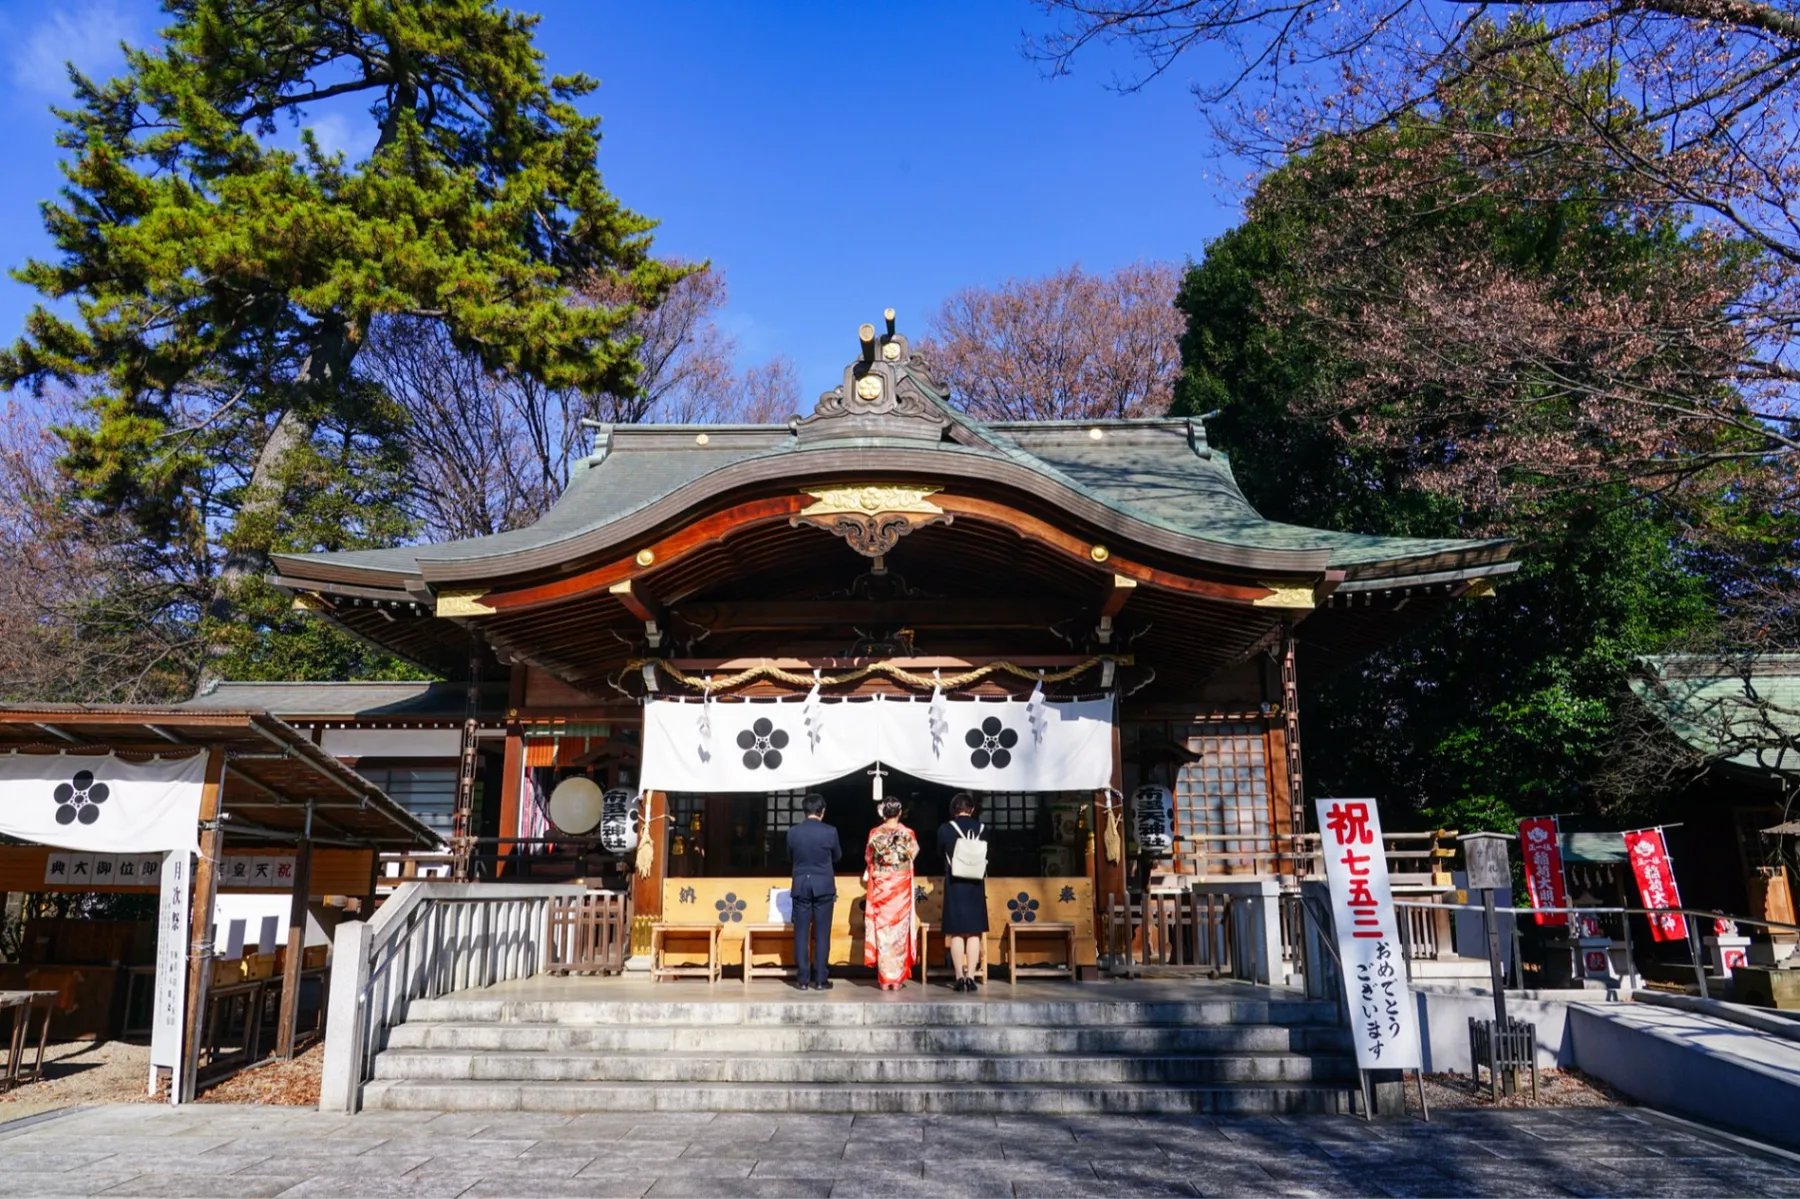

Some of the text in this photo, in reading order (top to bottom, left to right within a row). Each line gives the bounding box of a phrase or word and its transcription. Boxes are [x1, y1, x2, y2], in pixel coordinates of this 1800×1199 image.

[679, 886, 697, 904] 納
[1058, 884, 1076, 904] 奉
[1356, 962, 1384, 1061] ございます
[1376, 941, 1401, 1039] おめでとう
